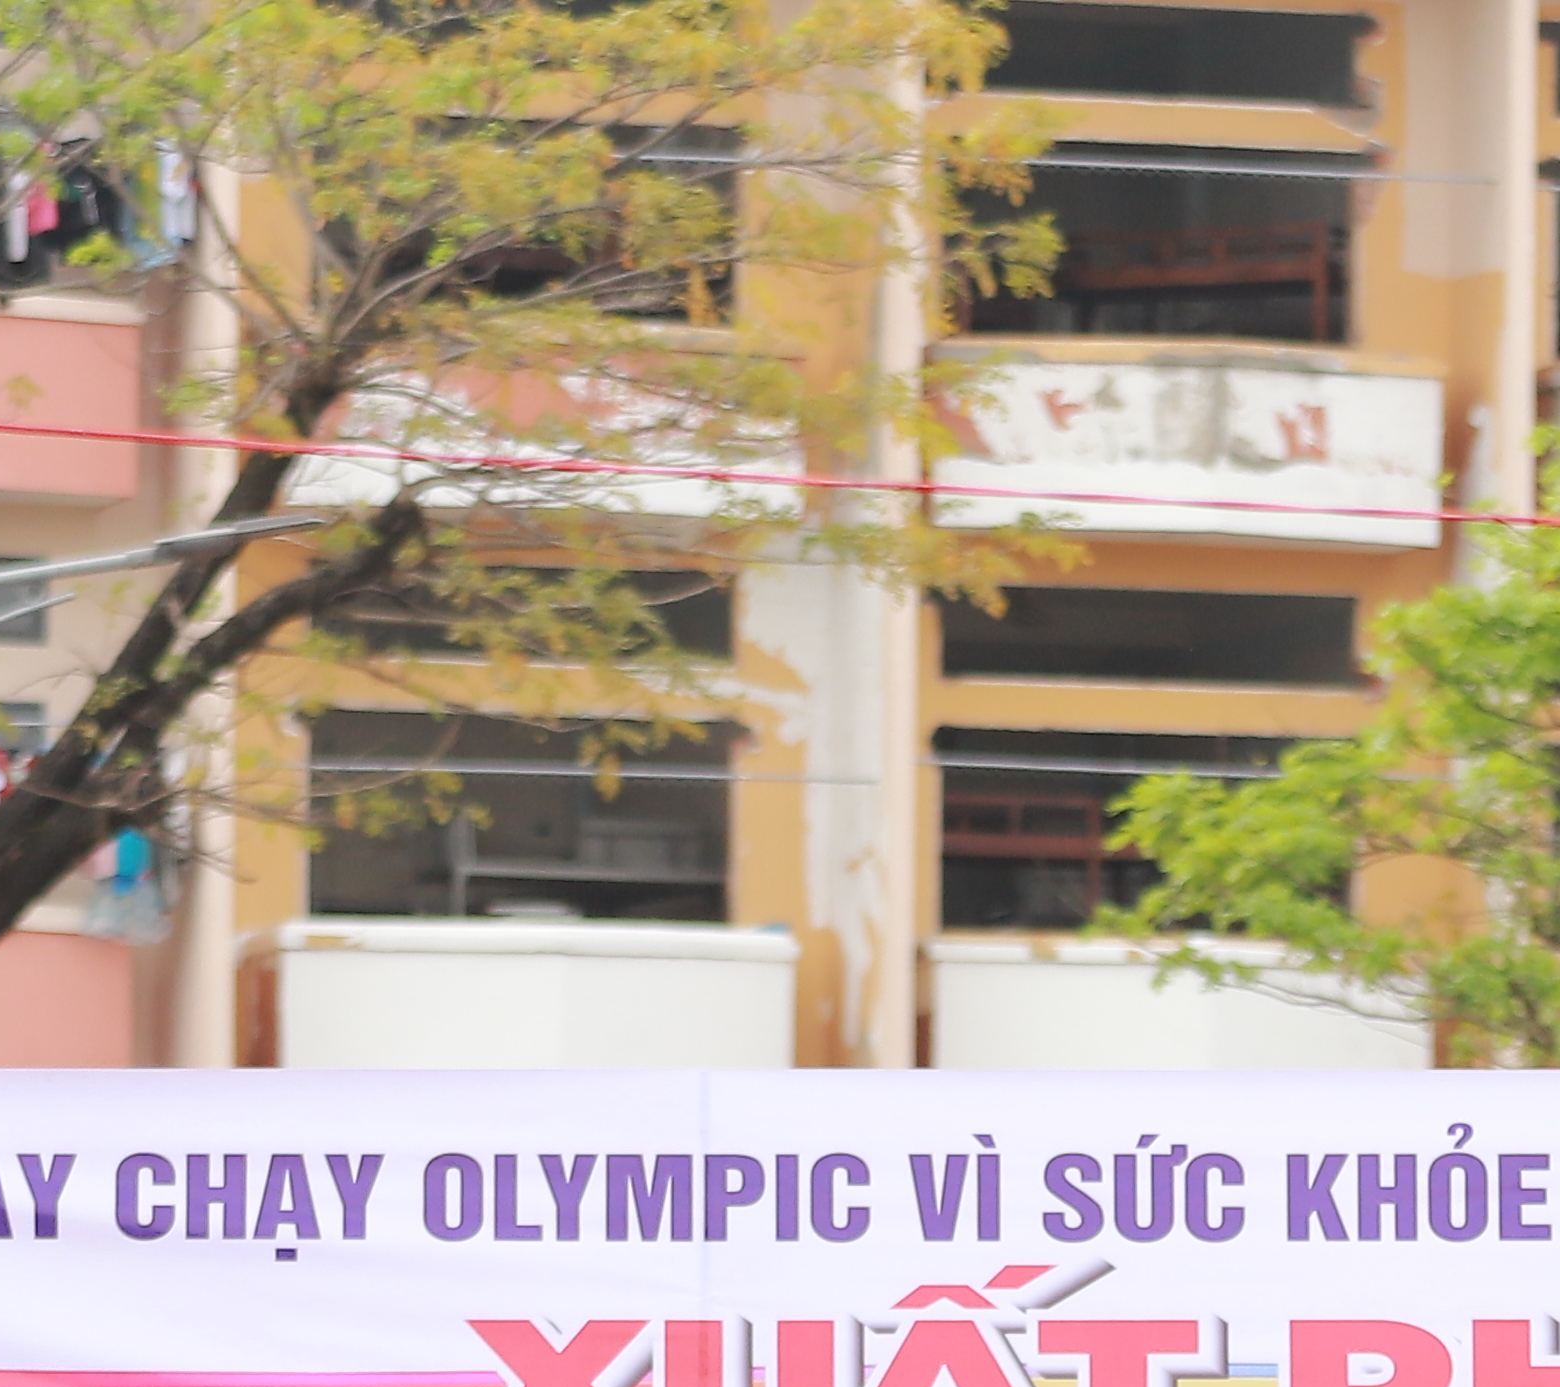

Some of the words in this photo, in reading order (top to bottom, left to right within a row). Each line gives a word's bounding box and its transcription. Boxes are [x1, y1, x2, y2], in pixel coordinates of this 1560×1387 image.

[114, 1151, 385, 1262] CHẠY
[422, 1151, 872, 1242] OLYMPIC
[909, 1132, 1002, 1242] VÌ
[1041, 1132, 1246, 1243] SỨC
[1285, 1122, 1553, 1242] KHỎE
